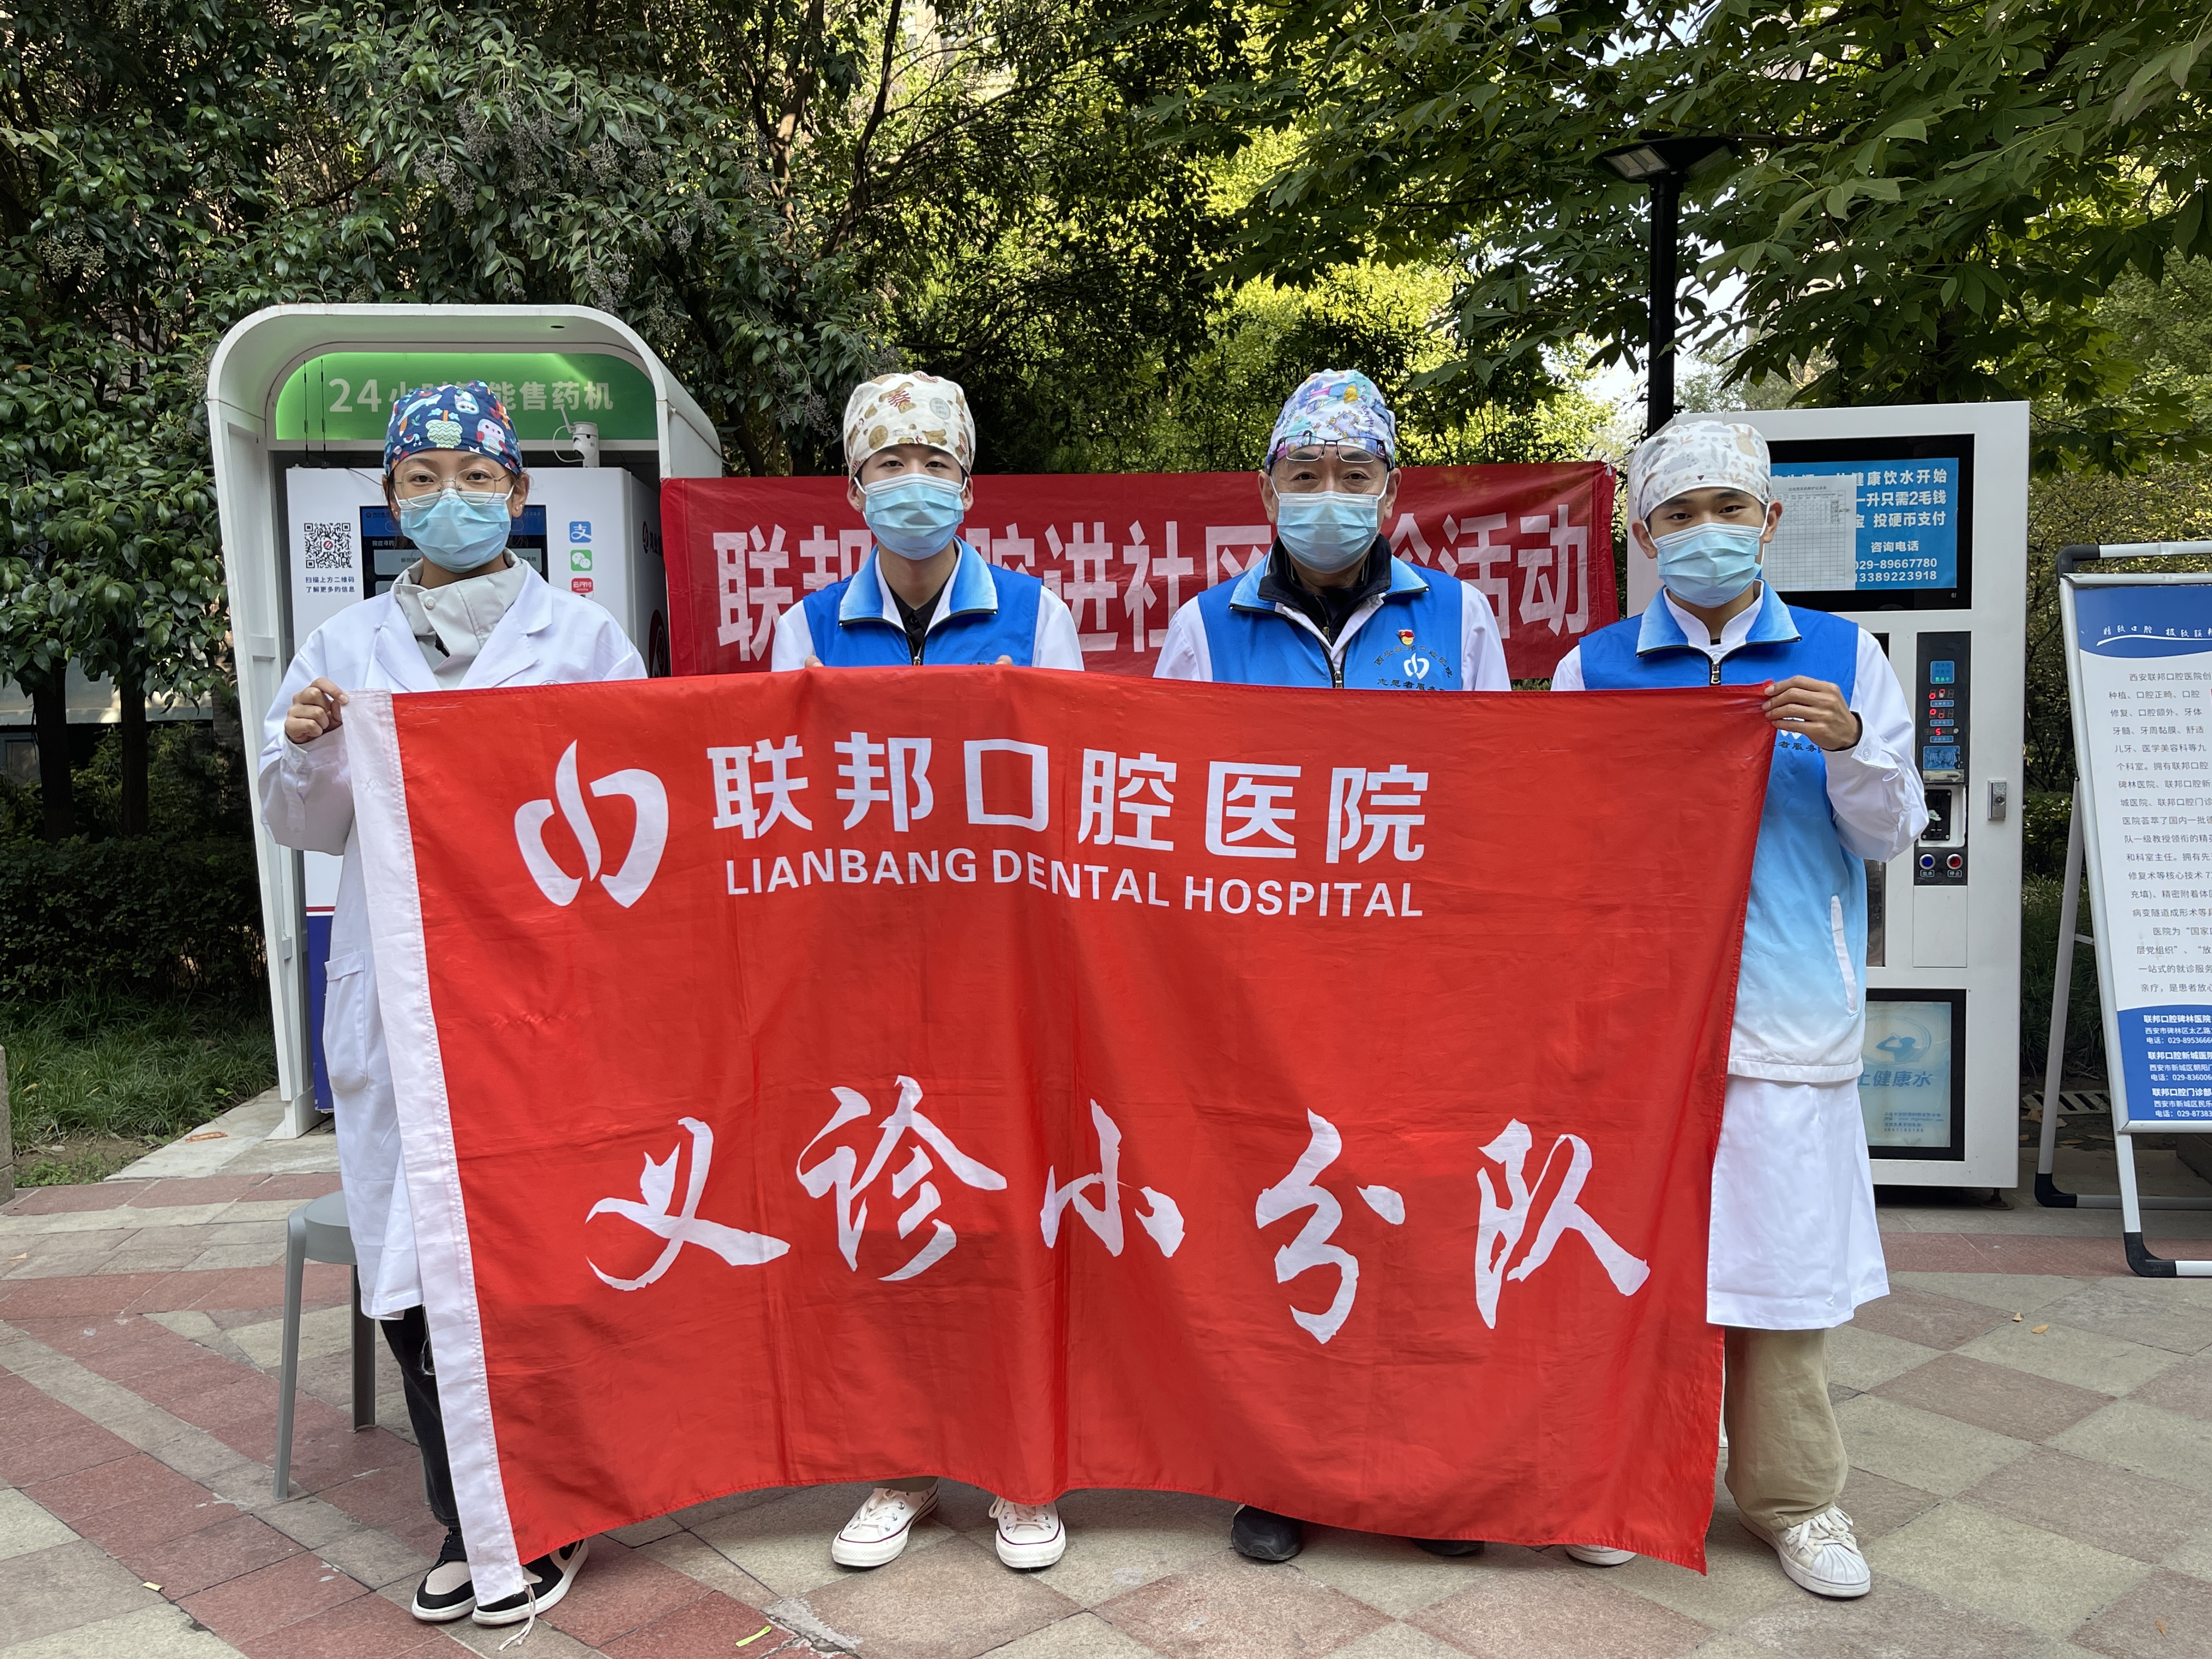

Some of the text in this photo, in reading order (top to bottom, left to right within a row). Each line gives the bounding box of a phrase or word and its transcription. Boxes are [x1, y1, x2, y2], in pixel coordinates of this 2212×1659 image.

[329, 378, 613, 413] 24能售药机
[1857, 489, 1946, 507] 一升只需2毛钱
[1874, 511, 1946, 528] 投硬币支付
[1871, 540, 1919, 553] 咨询电话
[1377, 678, 1445, 691] 志愿者服务
[1774, 741, 1822, 753] 者服务
[707, 732, 1429, 865] 联邦口腔医院
[2126, 853, 2212, 861] 和科室主任。拥有先
[726, 848, 1423, 917] LIANBANG DENTAL HOSPITAL
[2153, 927, 2212, 936] 医院为“国家
[2152, 1087, 2212, 1097] 联邦口腔门诊部
[584, 1075, 1652, 1345] 义诊小分队
